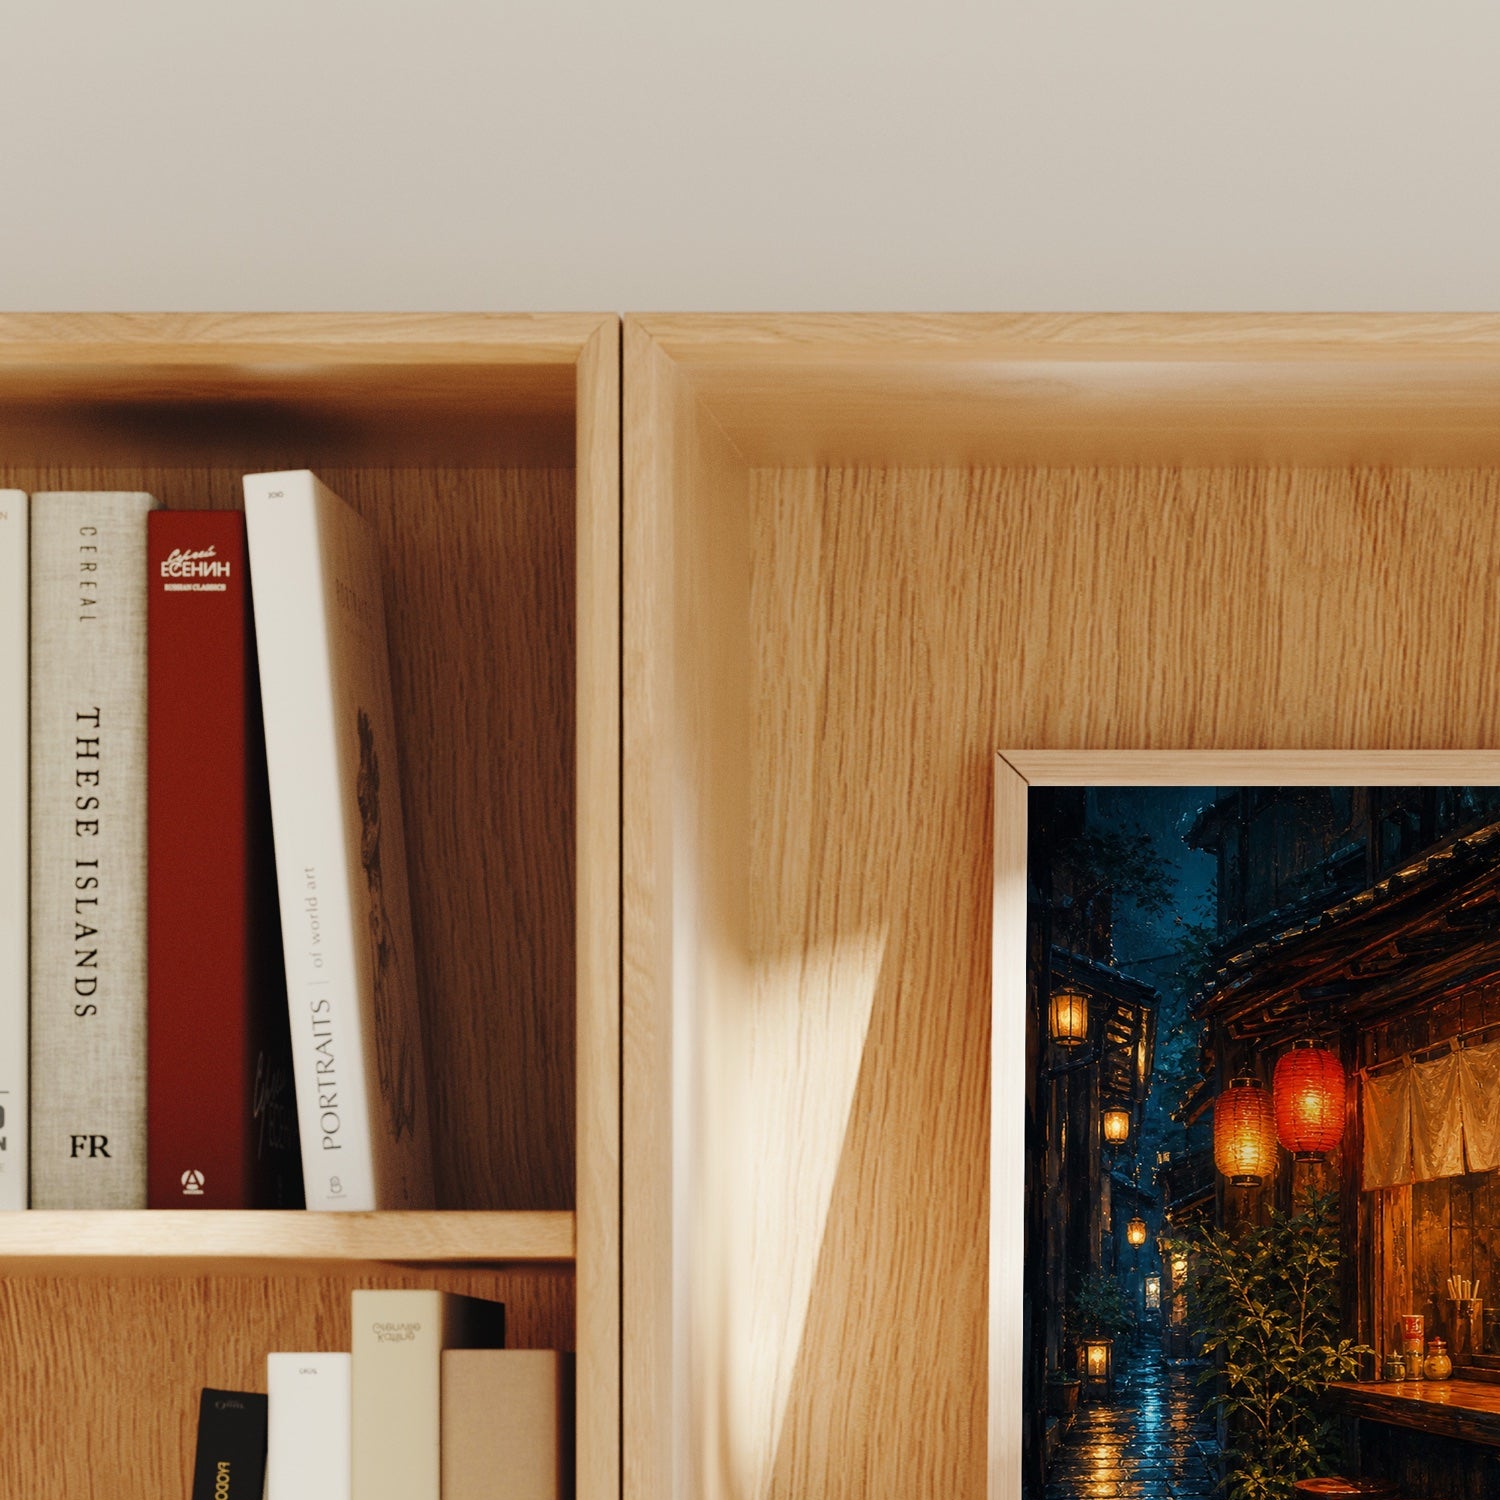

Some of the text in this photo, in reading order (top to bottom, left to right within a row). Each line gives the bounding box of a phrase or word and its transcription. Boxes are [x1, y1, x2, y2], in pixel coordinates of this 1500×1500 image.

[79, 526, 98, 623] CEREAL
[160, 561, 230, 577] ЕСЕНИН
[74, 707, 100, 1017] THESE ISLANDS
[303, 866, 342, 1152] PORTRAITS of world art
[69, 1133, 112, 1159] FR
